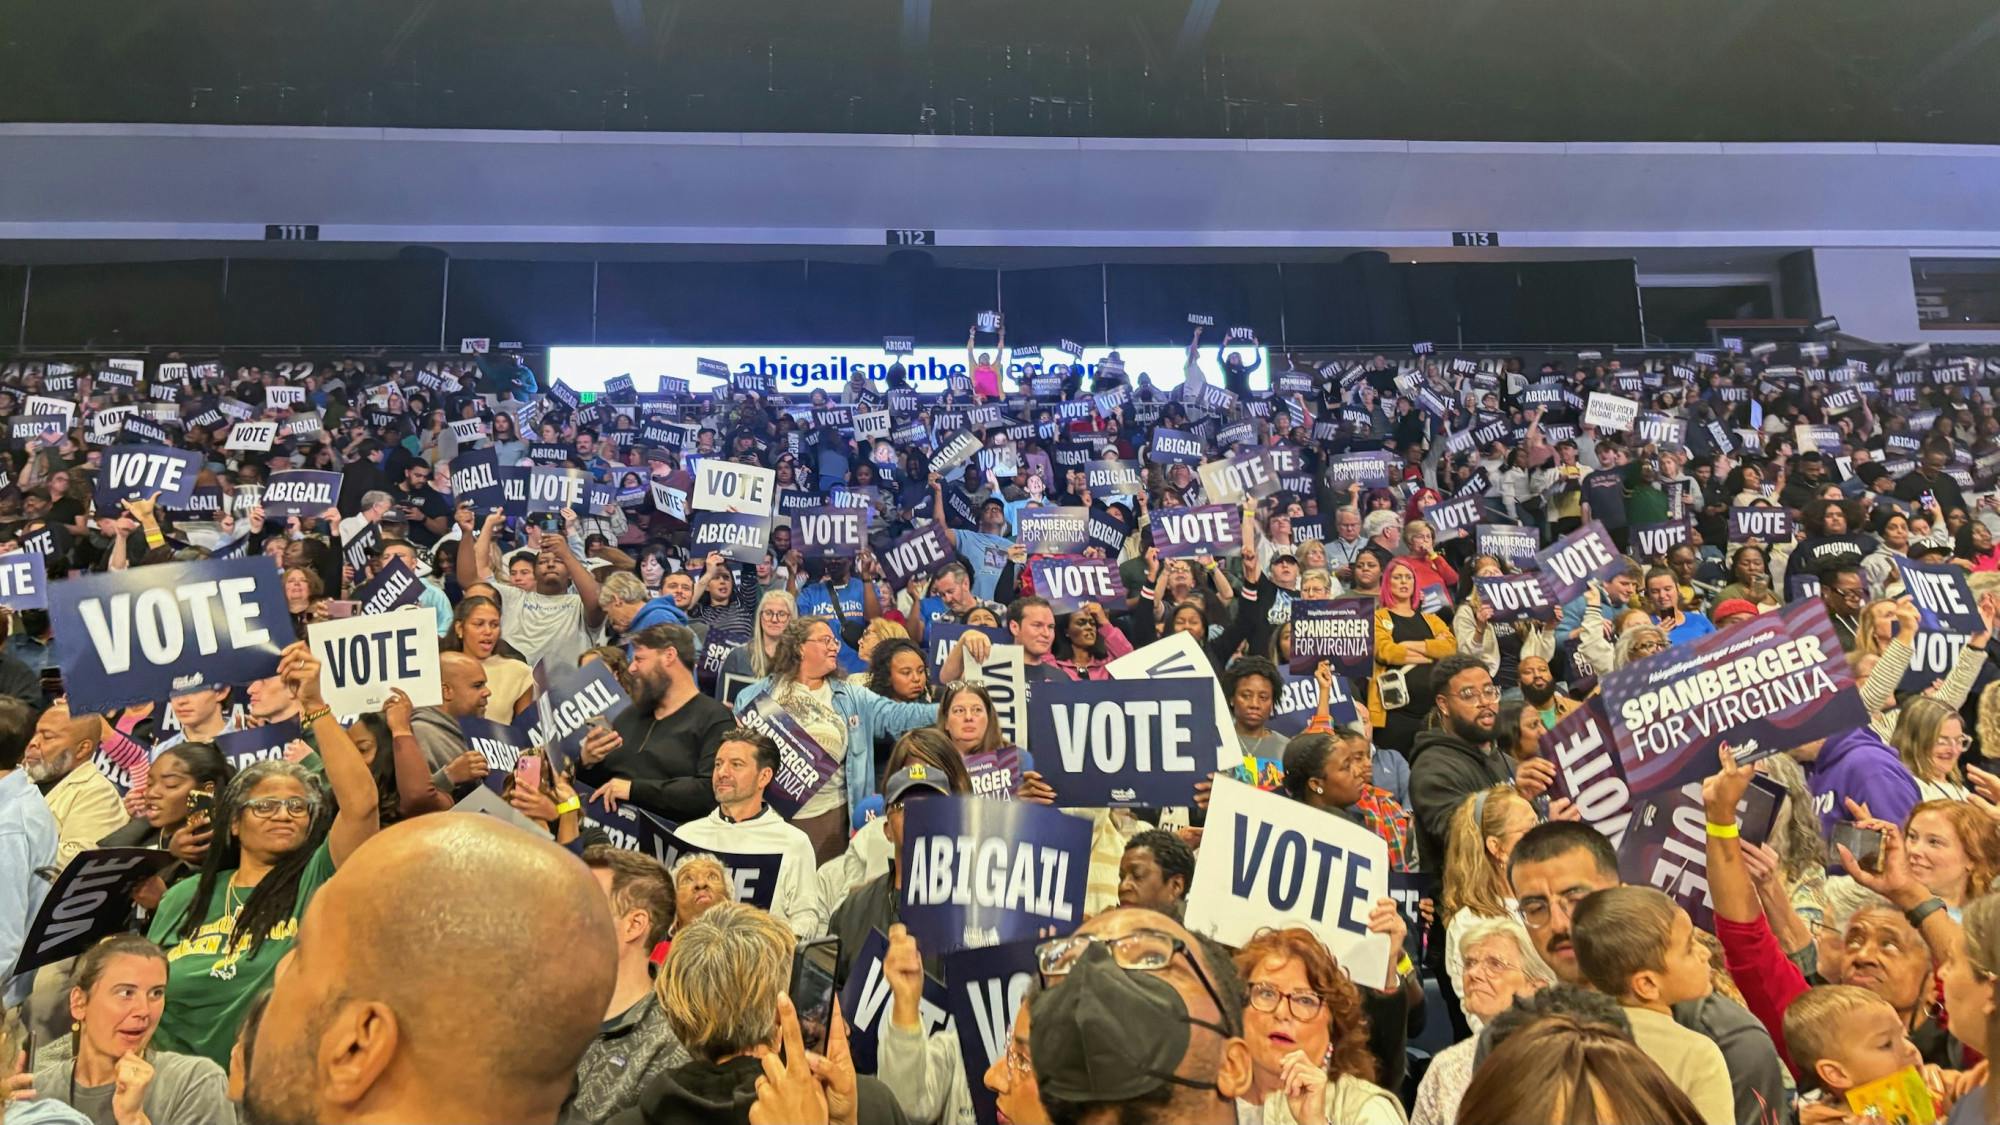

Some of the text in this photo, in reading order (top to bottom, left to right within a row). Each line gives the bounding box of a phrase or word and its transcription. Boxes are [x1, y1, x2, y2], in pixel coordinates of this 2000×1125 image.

[279, 226, 305, 240] 111
[897, 231, 925, 245] 112
[1462, 232, 1489, 246] 113
[977, 311, 1001, 328] VOTE
[1187, 314, 1214, 326] ABIGAIL
[1230, 328, 1254, 339] VOTE
[886, 341, 912, 350] ABIGAIL
[1013, 346, 1040, 355] ABIGAIL
[1061, 339, 1081, 355] VOTE
[1412, 342, 1434, 353] VOTE
[1454, 359, 1477, 374] VOTE
[1695, 352, 1717, 366] VOTE
[99, 371, 134, 386] ABIGAIL
[163, 366, 188, 379] VOTE
[1321, 362, 1342, 379] VOTE
[1672, 366, 1695, 382] VOTE
[1896, 371, 1924, 384] VOTE
[1932, 367, 1967, 384] VOTE
[45, 376, 74, 391] VOTE
[417, 370, 441, 390] VOTE
[606, 379, 632, 393] ABIGAIL
[662, 379, 687, 391] VOTE
[737, 375, 765, 390] VOTE
[1279, 377, 1312, 386] SPANBERGER
[1620, 379, 1642, 391] VOTE
[150, 384, 177, 401] VOTE
[271, 390, 300, 403] VOTE
[1100, 389, 1129, 410] VOTE
[1204, 387, 1232, 409] VOTE
[1525, 390, 1561, 402] ABIGAIL
[1563, 390, 1584, 409] VOTE
[1721, 388, 1748, 401] VOTE
[1824, 390, 1857, 409] VOTE
[1894, 388, 1916, 402] VOTE
[892, 398, 917, 411] VOTE
[1060, 403, 1089, 417] VOTE
[1247, 402, 1270, 417] VOTE
[186, 409, 222, 430] ABIGAIL
[576, 406, 599, 426] VOTE
[817, 409, 850, 425] VOTE
[857, 415, 887, 432] VOTE
[967, 407, 997, 424] VOTE
[124, 419, 166, 441] ABIGAIL
[235, 427, 270, 442] VOTE
[453, 422, 478, 436] VOTE
[644, 428, 679, 445] ABIGAIL
[1006, 425, 1035, 440] VOTE
[1216, 424, 1252, 441] SPANBERGER
[1475, 421, 1508, 445] VOTE
[1549, 425, 1575, 439] VOTE
[1640, 421, 1680, 443] VOTE
[928, 434, 972, 473] ABIGAIL
[1156, 436, 1202, 457] ABIGAIL
[978, 448, 1010, 472] VOTE
[1333, 460, 1385, 472] SPANBERGER
[109, 453, 187, 492] VOTE
[1089, 468, 1139, 487] ABIGAIL
[1210, 456, 1270, 498] VOTE
[1334, 469, 1385, 480] FOR VIRGINIA
[263, 482, 332, 504] ABIGAIL
[530, 474, 584, 504] VOTE
[707, 469, 764, 503] VOTE
[656, 487, 687, 513] VOTE
[782, 495, 822, 508] ABIGAIL
[1431, 499, 1481, 531] VOTE
[1737, 512, 1786, 534] VOTE
[800, 514, 859, 545] VOTE
[1022, 519, 1084, 531] SPANBERGER
[1160, 512, 1233, 544] VOTE
[696, 522, 763, 549] ABIGAIL
[1023, 531, 1084, 543] FOR VIRGINIA
[1089, 518, 1124, 550] ABIGAIL
[1480, 536, 1536, 548] SPANBERGER
[1638, 526, 1686, 554] VOTE
[347, 530, 376, 572] VOTE
[886, 530, 946, 579] VOTE
[1482, 546, 1536, 557] FOR VIRGINIA
[1812, 542, 1862, 557] VIRGINIA
[1547, 532, 1614, 586] VOTE
[0, 563, 34, 596] TE
[1042, 566, 1116, 599] VOTE
[361, 569, 413, 616] ABIGAIL
[1483, 579, 1548, 610] VOTE
[1902, 566, 1969, 614] VOTE
[78, 577, 270, 676] VOTE
[1295, 619, 1369, 638] SPANBERGER
[1295, 638, 1368, 656] FOR VIRGINIA
[1909, 632, 1972, 672] VOT
[325, 628, 421, 689] VOTE
[1620, 634, 1828, 732] SPANBERGER
[1631, 666, 1838, 761] FOR VIRGINIA
[1051, 700, 1196, 774] VOTE
[742, 709, 819, 789] SPANBERGER
[907, 834, 1073, 922] ABIGAIL
[1232, 812, 1372, 936] VOTE
[36, 854, 145, 955] VOTE
